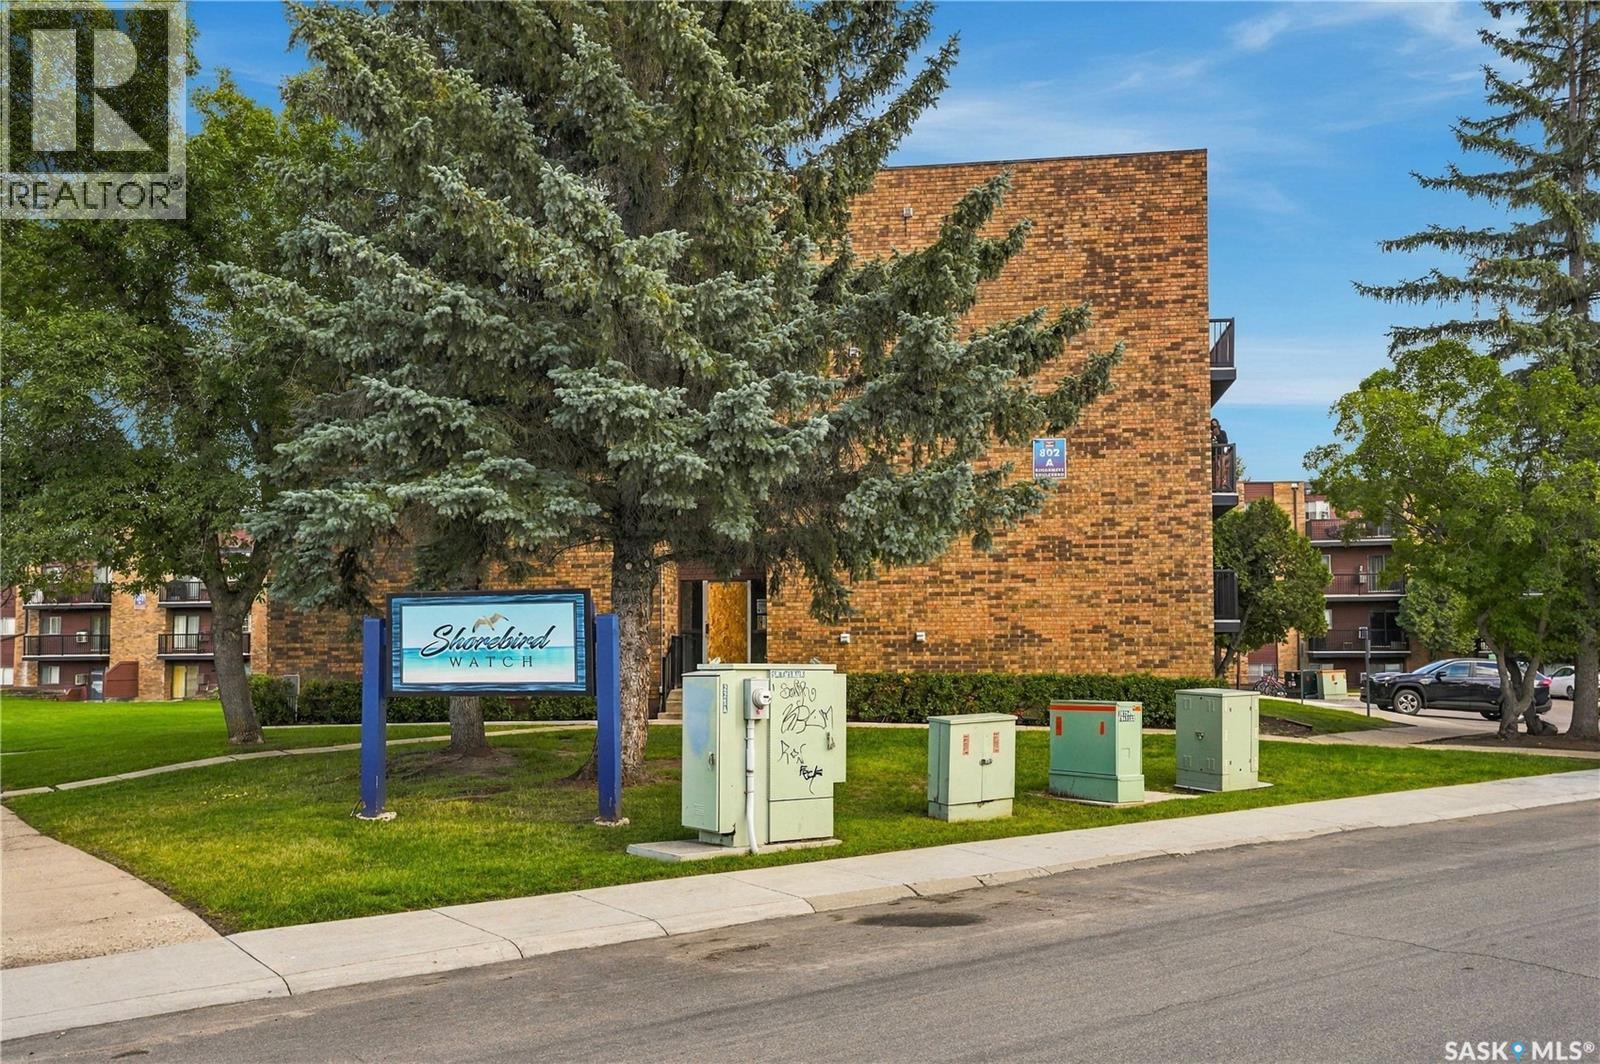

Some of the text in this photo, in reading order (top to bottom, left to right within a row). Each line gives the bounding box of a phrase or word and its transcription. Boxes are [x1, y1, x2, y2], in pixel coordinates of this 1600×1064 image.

[1039, 448, 1060, 457] 802
[1045, 458, 1054, 467] A
[420, 624, 556, 657] Shorebird
[450, 655, 533, 668] WATCH
